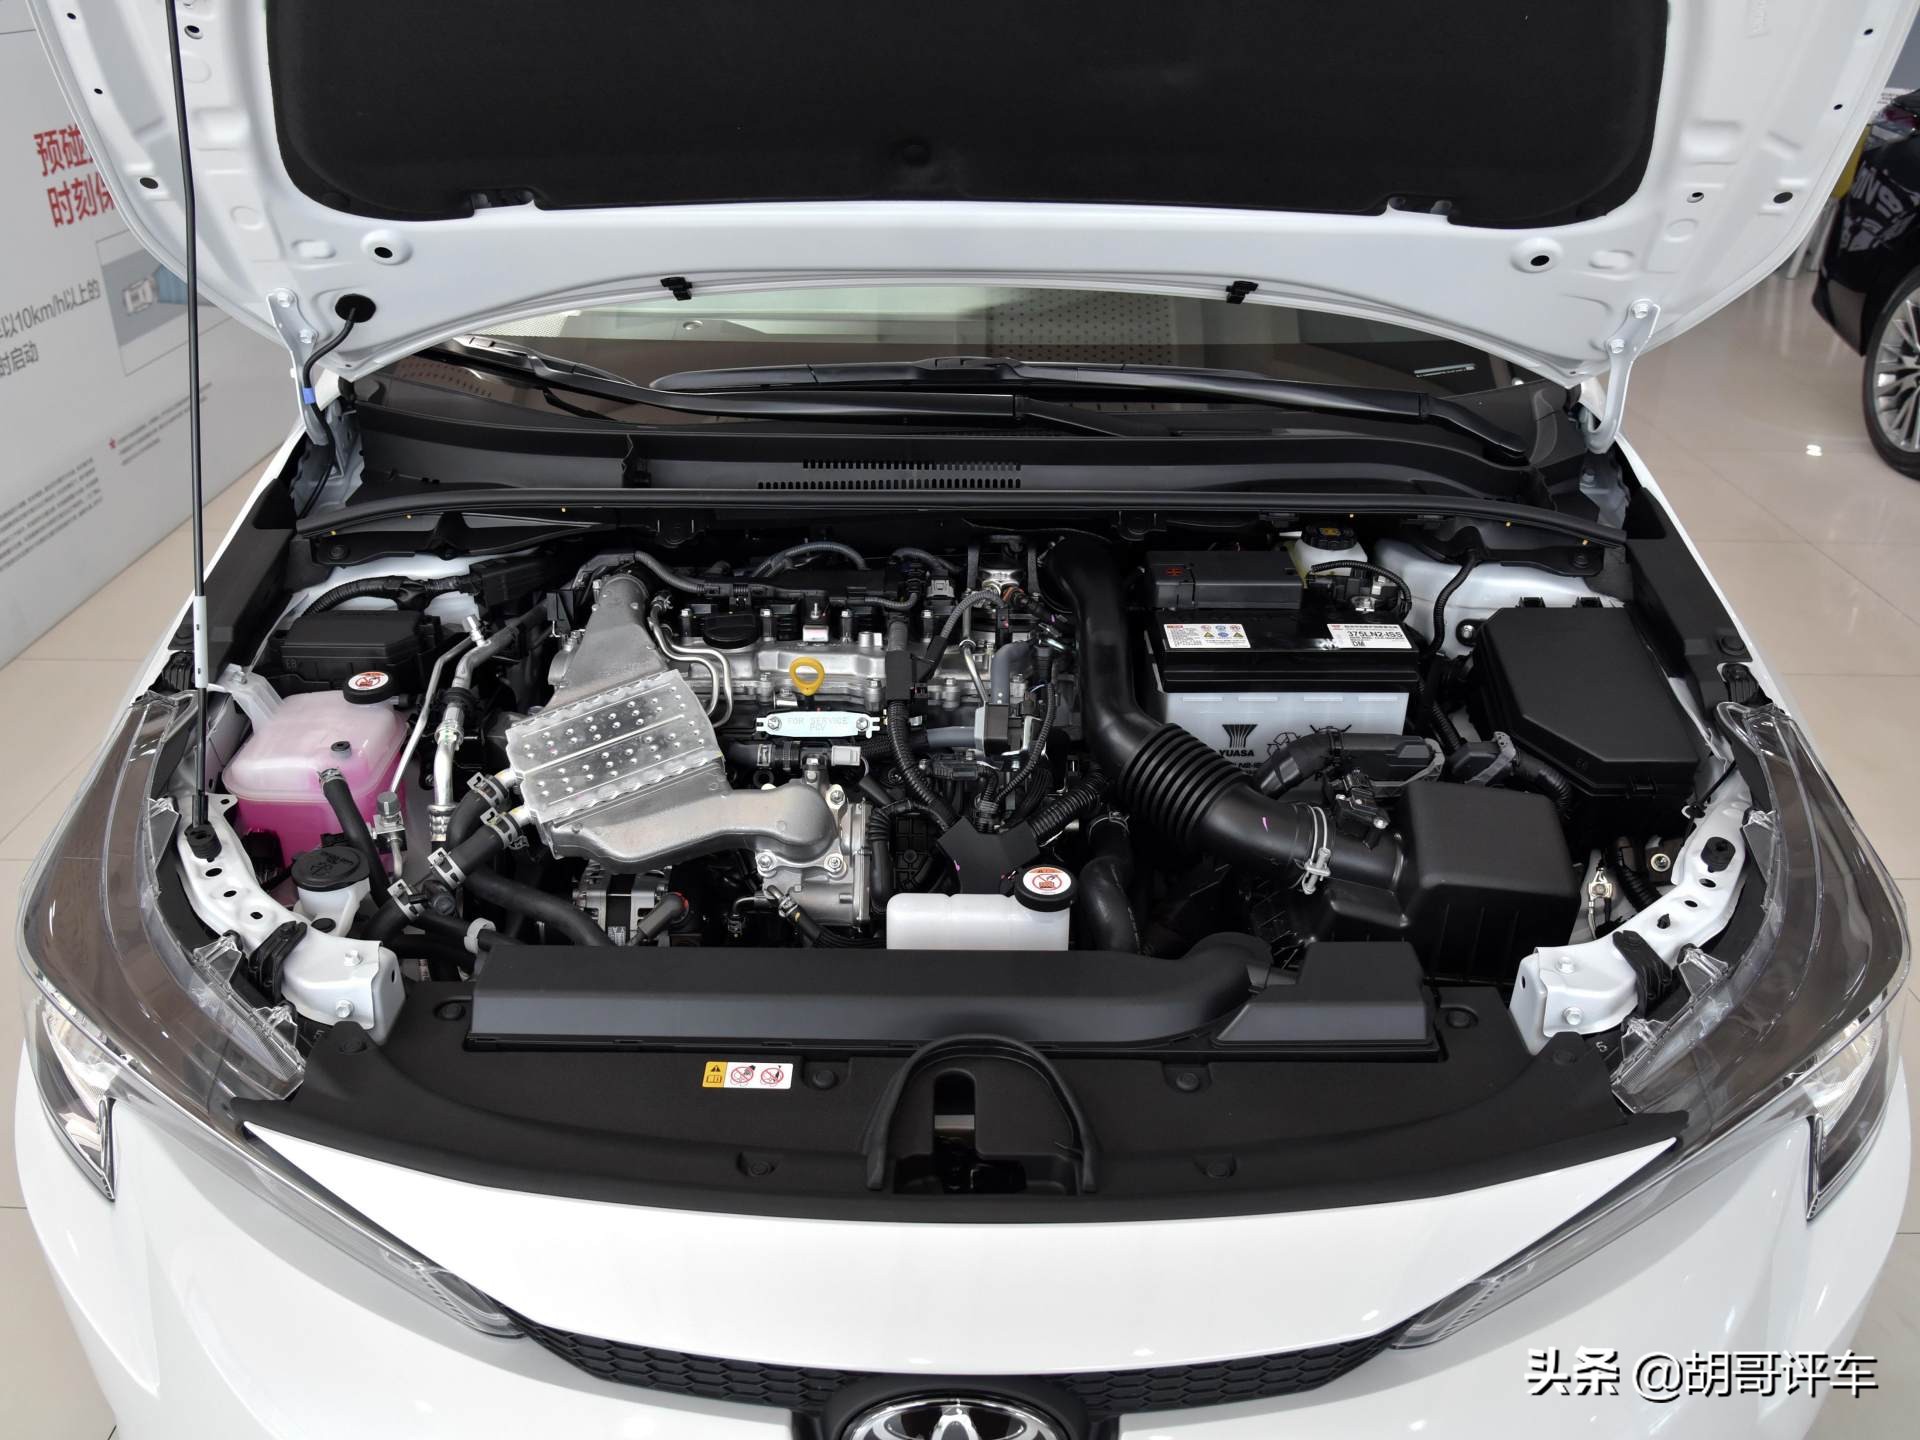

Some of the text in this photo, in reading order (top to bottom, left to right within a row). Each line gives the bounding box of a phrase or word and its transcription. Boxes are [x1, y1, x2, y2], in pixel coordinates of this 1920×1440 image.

[33, 123, 94, 177] 预碰
[0, 278, 101, 338] 以10km/h以上的
[1219, 749, 1255, 757] YUASA
